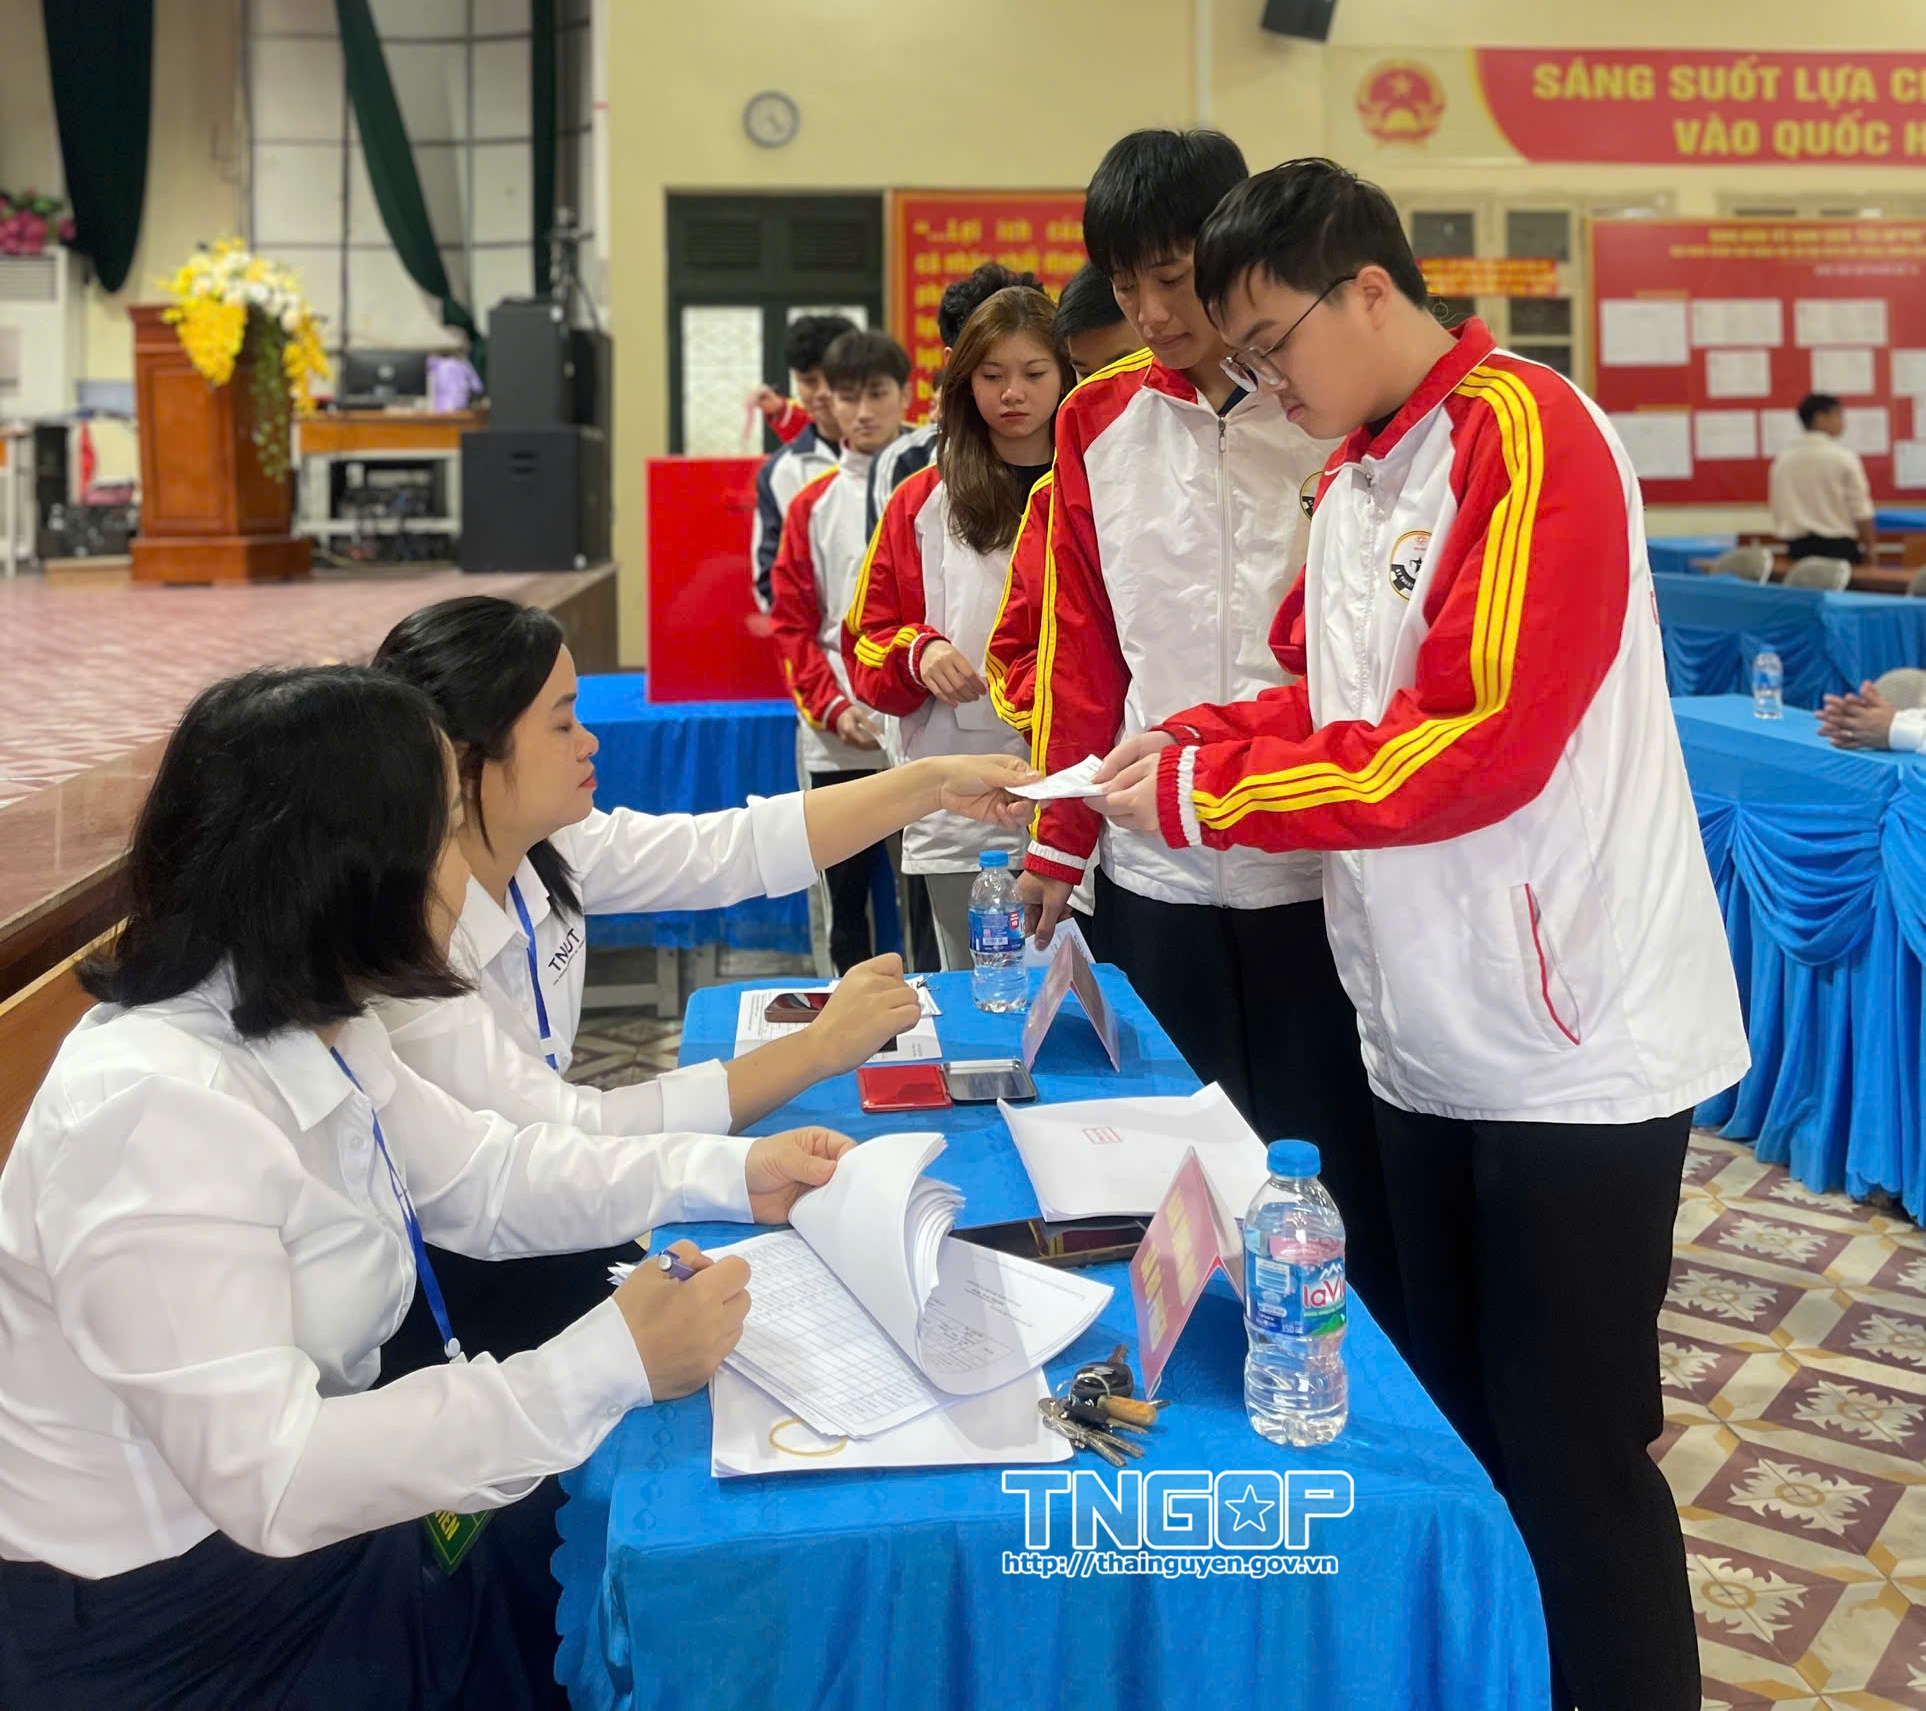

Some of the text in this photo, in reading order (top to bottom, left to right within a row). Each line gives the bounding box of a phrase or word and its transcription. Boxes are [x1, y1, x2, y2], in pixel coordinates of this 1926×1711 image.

[1532, 53, 1926, 109] SÁNG SUỐT LỰA C
[1673, 111, 1760, 157] VÀO
[1773, 108, 1891, 159] QUỐC
[547, 927, 580, 971] TNUT
